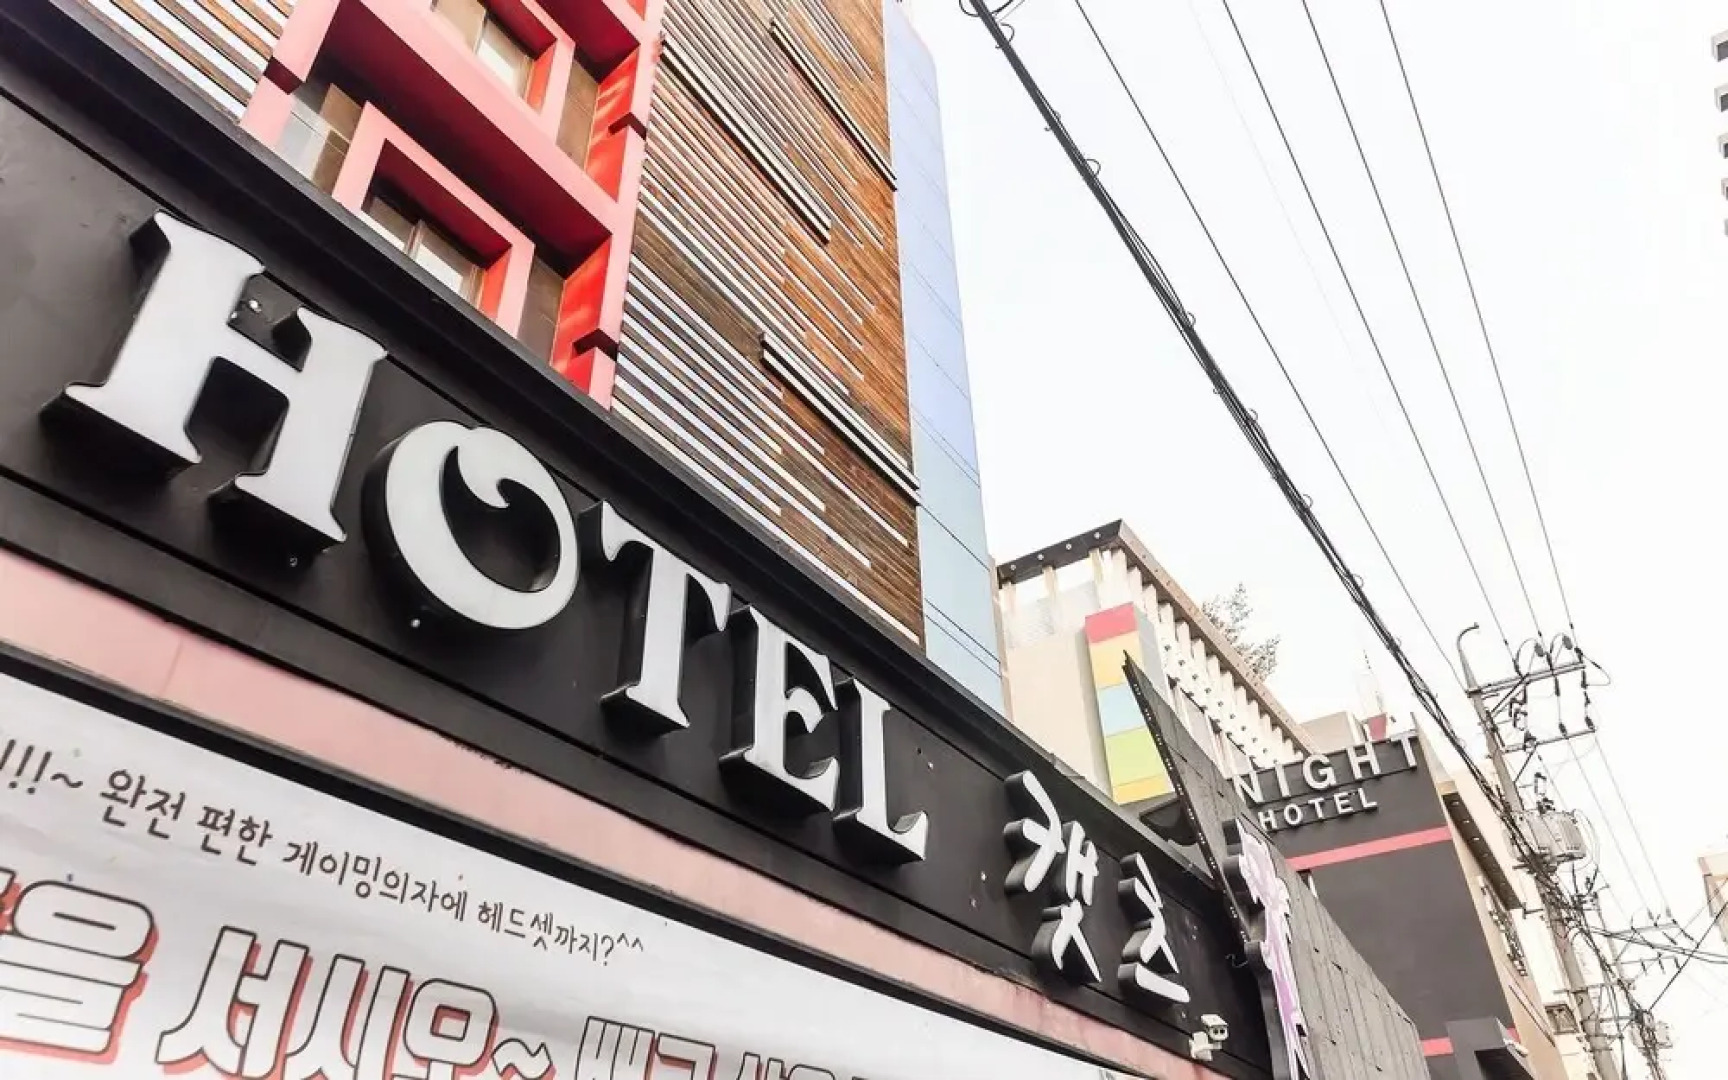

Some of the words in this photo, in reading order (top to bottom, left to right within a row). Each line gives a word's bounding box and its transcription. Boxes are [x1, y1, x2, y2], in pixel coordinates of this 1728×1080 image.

[58, 211, 930, 864] HOTEL
[1015, 769, 1190, 1003] 캣츠
[1233, 730, 1418, 804] NIGHT
[1257, 787, 1378, 831] HOTEL
[100, 769, 186, 839] 완전
[197, 805, 273, 866] 편한
[282, 841, 467, 922] 게이밍의자에
